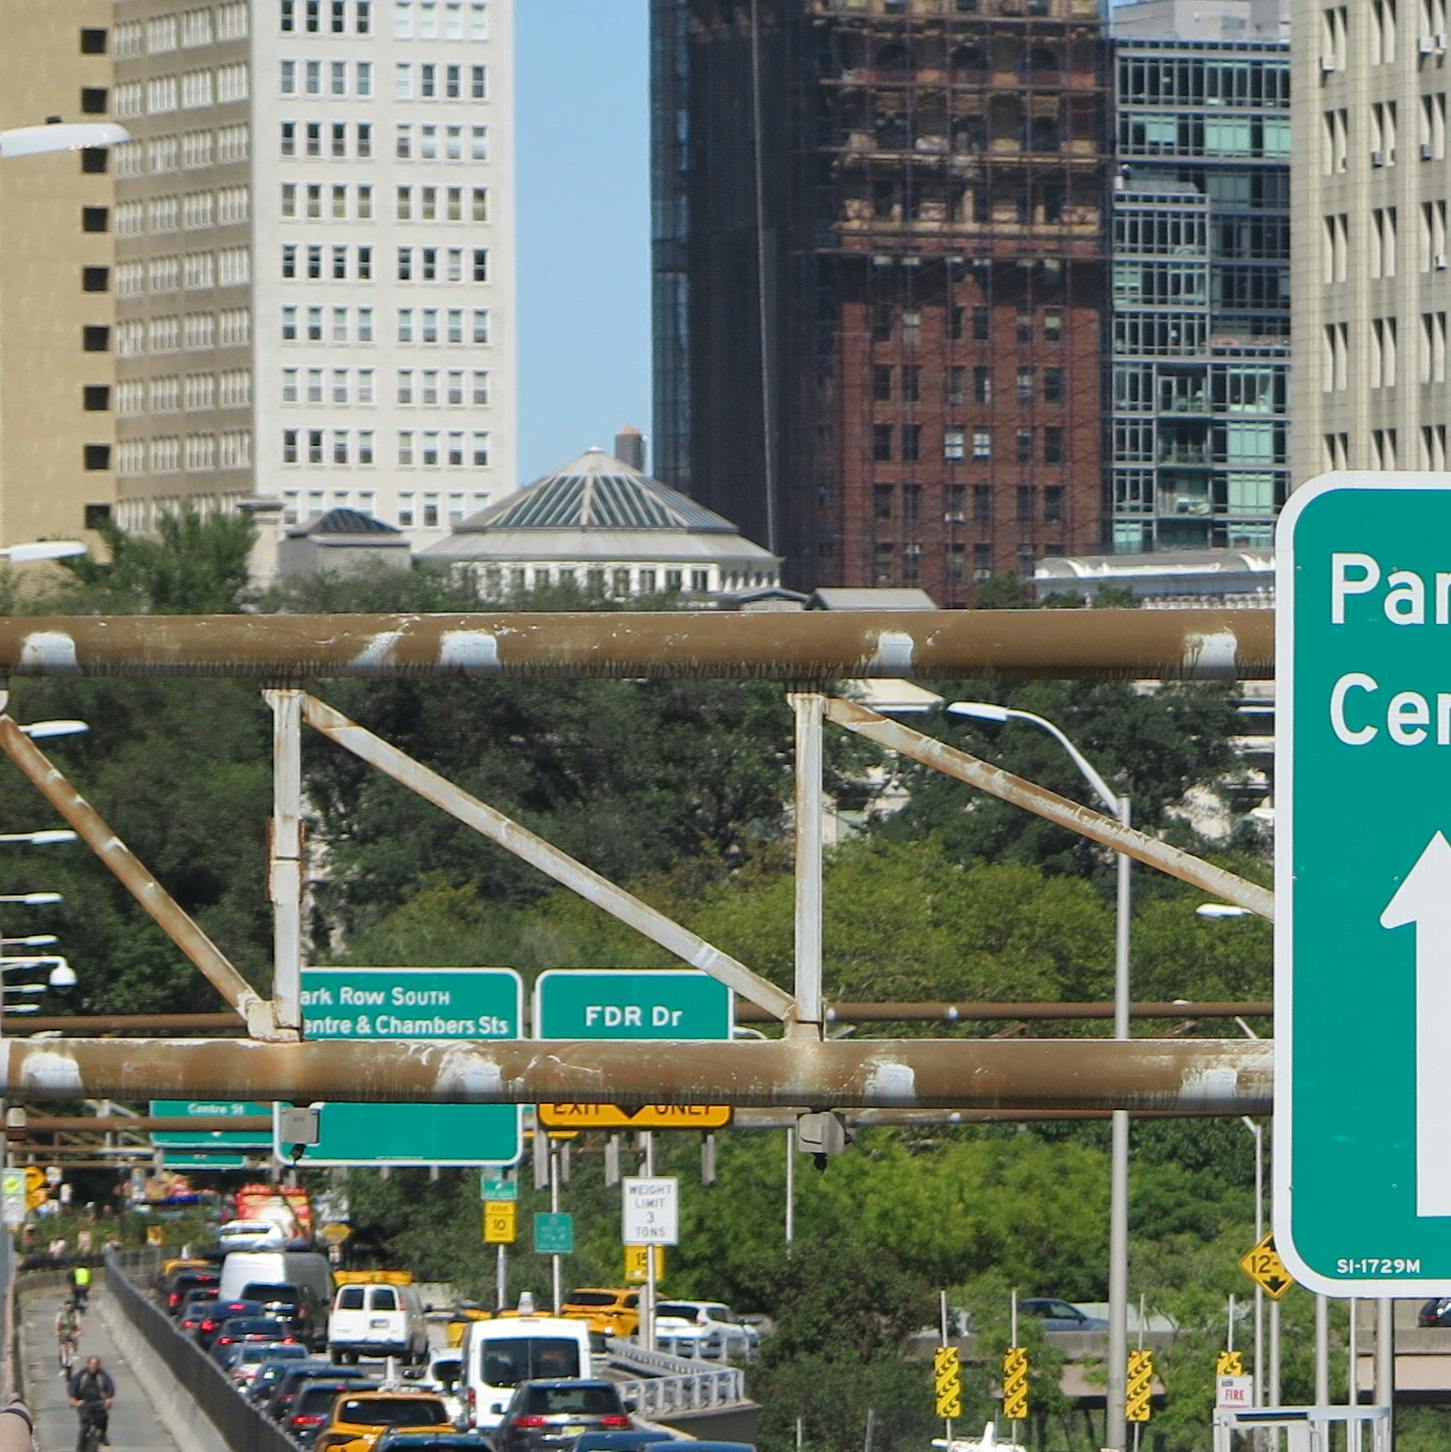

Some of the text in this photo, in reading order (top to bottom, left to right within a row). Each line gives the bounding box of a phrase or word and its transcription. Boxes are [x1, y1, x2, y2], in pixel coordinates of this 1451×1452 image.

[299, 986, 450, 1007] ark Row SOUTH
[585, 1005, 683, 1027] FDR Dr
[304, 1016, 509, 1035] entre & Chambers Sts
[635, 1198, 666, 1208] LIMIT
[646, 1211, 655, 1223] 3
[636, 1226, 666, 1237] TONS
[1336, 1258, 1421, 1274] SI-1729M
